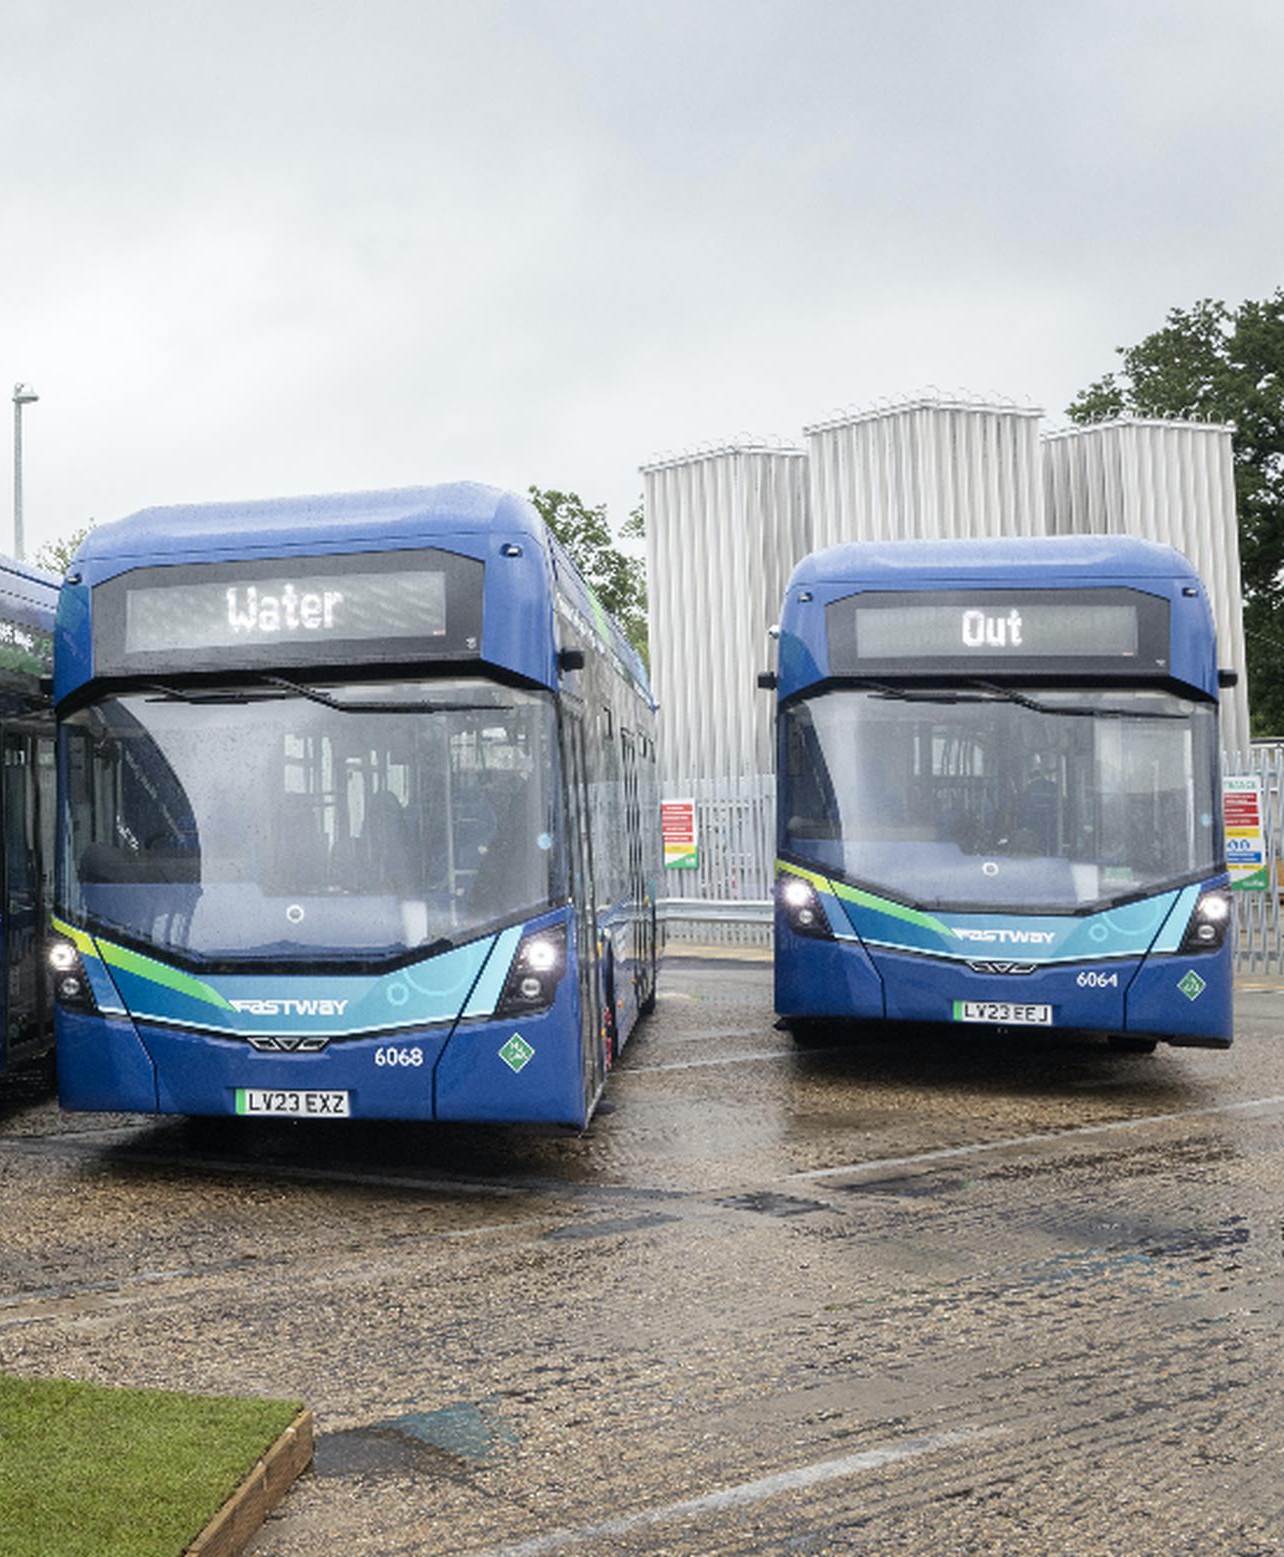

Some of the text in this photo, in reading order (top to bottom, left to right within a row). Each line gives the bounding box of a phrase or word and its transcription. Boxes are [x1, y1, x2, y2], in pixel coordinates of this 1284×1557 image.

[226, 582, 344, 632] Water
[961, 608, 1023, 647] Out
[1076, 972, 1118, 988] 6064
[964, 1003, 1049, 1022] LV23 EEJ
[374, 1047, 423, 1067] 6068
[248, 1093, 345, 1113] LV23 EXZ
